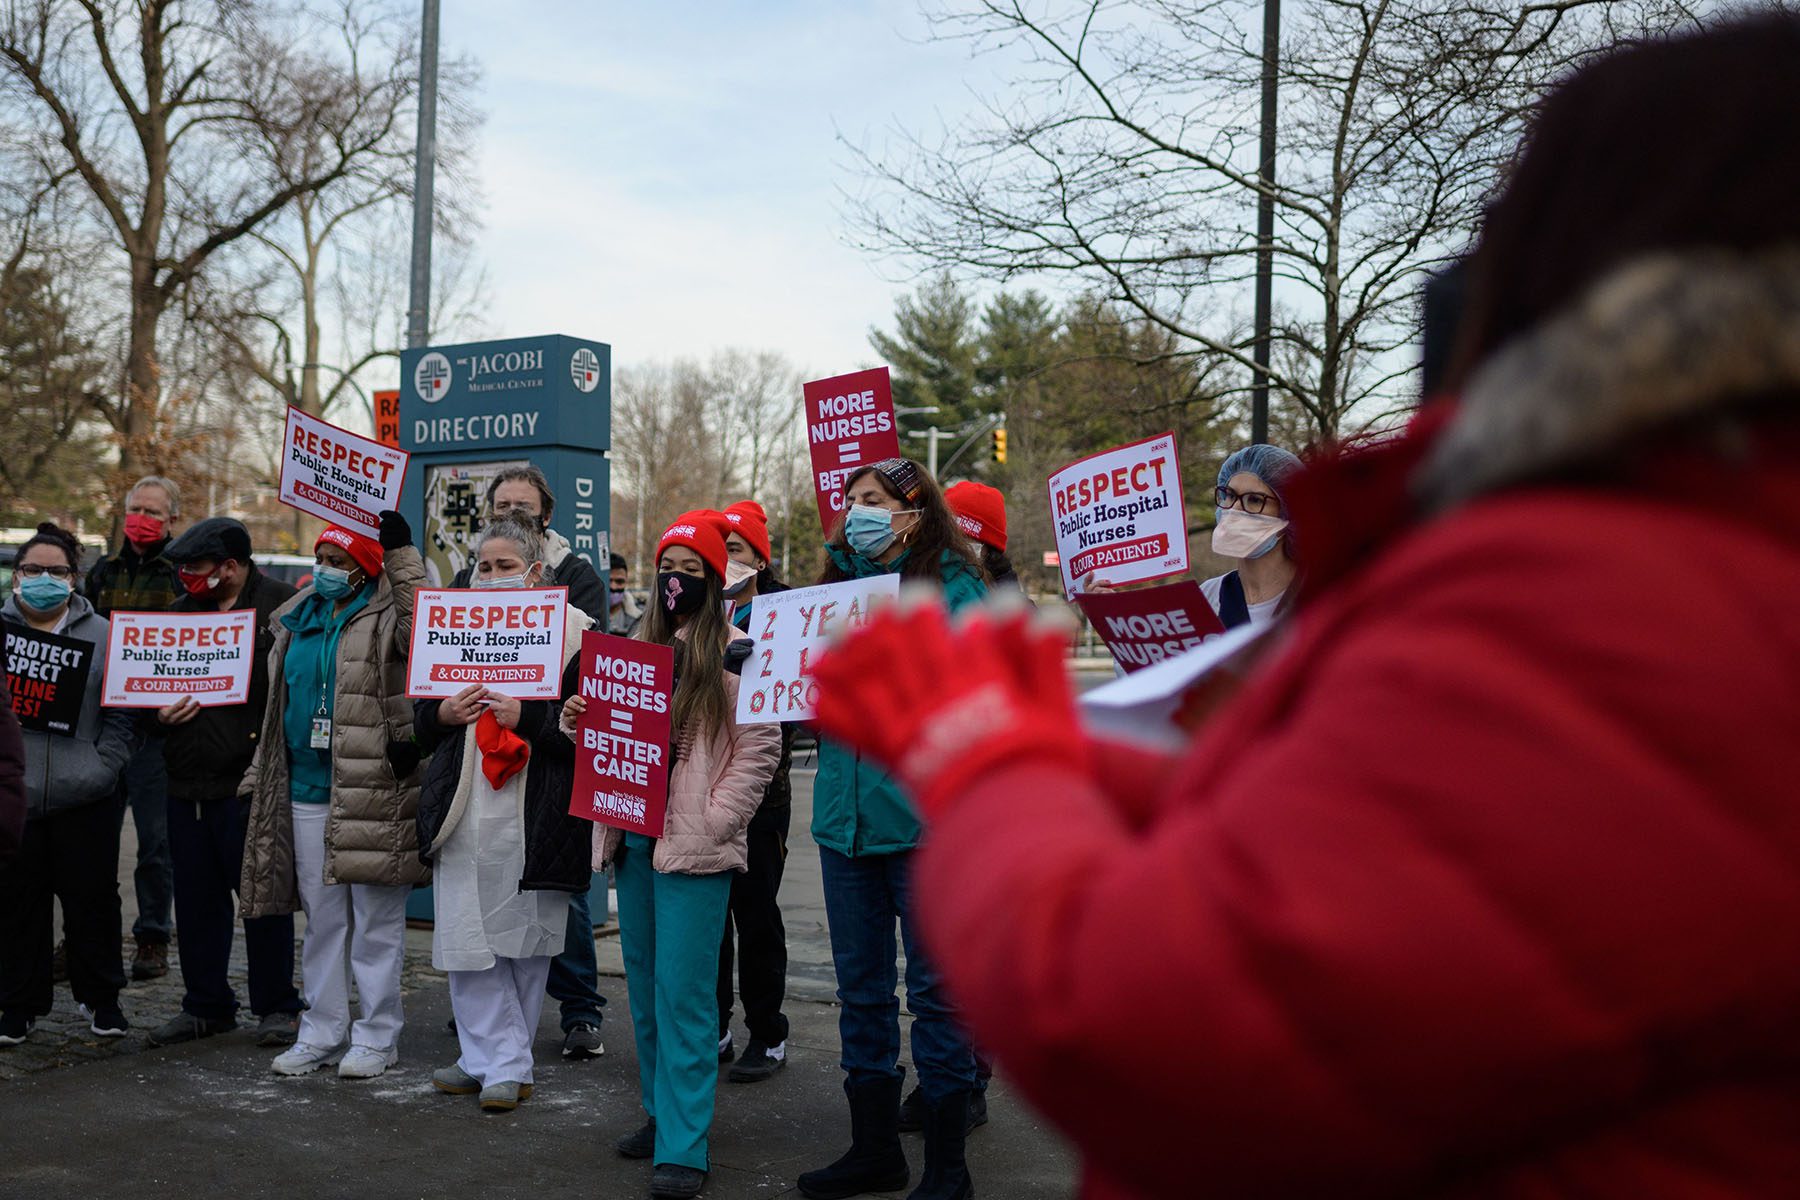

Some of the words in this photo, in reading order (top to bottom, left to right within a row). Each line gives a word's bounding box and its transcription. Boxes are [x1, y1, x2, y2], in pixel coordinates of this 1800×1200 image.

[468, 350, 544, 381] JACOBI
[468, 382, 506, 392] MEDICAL
[508, 379, 543, 389] CENTER
[818, 390, 876, 419] MORE
[415, 412, 539, 444] DIRECTORY
[811, 412, 891, 443] NURSES
[293, 424, 395, 484] RESPECT
[292, 448, 329, 475] Public
[331, 466, 387, 500] Hospital
[314, 473, 358, 503] Nurses
[819, 467, 862, 491] BET
[1056, 456, 1166, 518] RESPECT
[298, 485, 307, 495] &
[307, 489, 329, 505] OUR
[330, 499, 374, 526] PATIENTS
[1060, 512, 1091, 538] Public
[1094, 490, 1169, 524] Hospital
[1078, 523, 1136, 549] Nurses
[1073, 558, 1079, 574] &
[1078, 553, 1095, 573] OUR
[1096, 540, 1161, 566] PATIENTS
[428, 605, 555, 629] RESPECT
[760, 609, 778, 642] 2
[1105, 609, 1196, 639] MORE
[5, 633, 83, 668] PROTECT
[122, 625, 244, 647] RESPECT
[427, 631, 481, 646] Public
[485, 631, 551, 649] Hospital
[6, 654, 62, 683] SPECT
[122, 648, 172, 661] Public
[176, 647, 240, 664] Hospital
[153, 663, 210, 676] Nurses
[460, 649, 519, 662] Nurses
[595, 654, 655, 686] MORE
[760, 648, 774, 678] 2
[132, 679, 142, 690] &
[144, 680, 171, 691] OUR
[174, 680, 227, 691] PATIENTS
[438, 668, 448, 679] &
[451, 669, 480, 680] OUR
[482, 668, 537, 680] PATIENTS
[582, 676, 667, 714] NURSES
[584, 728, 662, 766] BETTER
[593, 753, 648, 786] CARE
[593, 791, 646, 818] NURSES
[612, 789, 623, 798] New
[623, 792, 634, 801] York
[592, 806, 646, 825] ASSOCIATION
